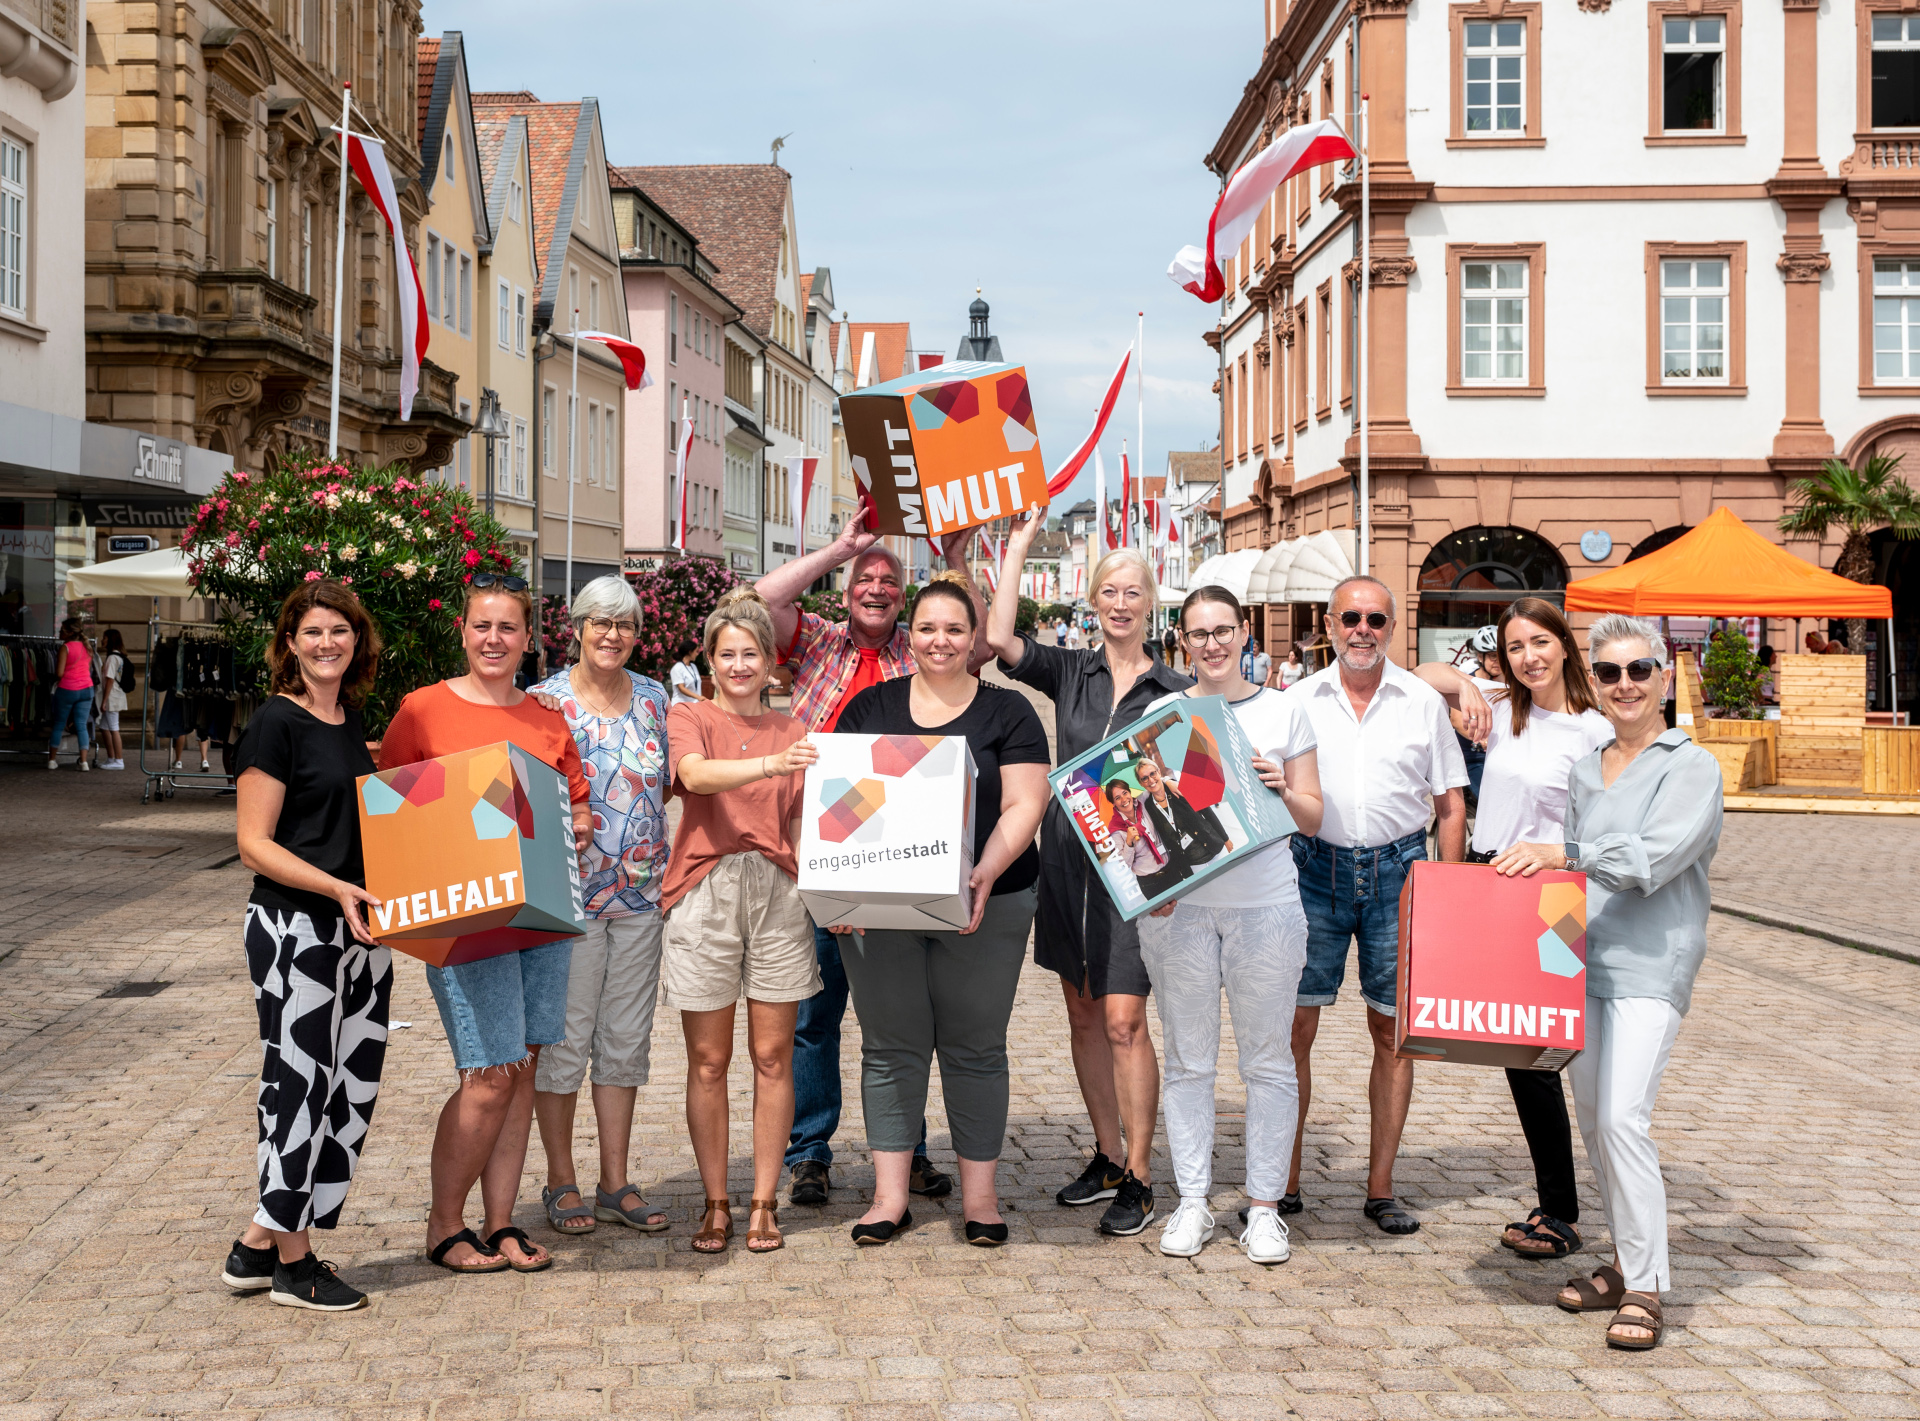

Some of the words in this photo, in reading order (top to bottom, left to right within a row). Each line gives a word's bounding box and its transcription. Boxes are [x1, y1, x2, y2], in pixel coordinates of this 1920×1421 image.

[134, 436, 182, 484] Schmitt
[883, 419, 928, 535] MUT
[94, 504, 192, 526] Schmitt
[925, 462, 1025, 533] MUT
[115, 540, 145, 550] Grasgasse
[624, 556, 656, 569] sbank
[1220, 700, 1262, 835] ENGAGEMENT
[556, 776, 585, 922] VIELFALT
[808, 840, 949, 871] engagiertestadt
[1065, 779, 1142, 901] ENGAGEMENT
[374, 870, 518, 931] VIELFALT
[1414, 996, 1581, 1040] ZUKUNFT
